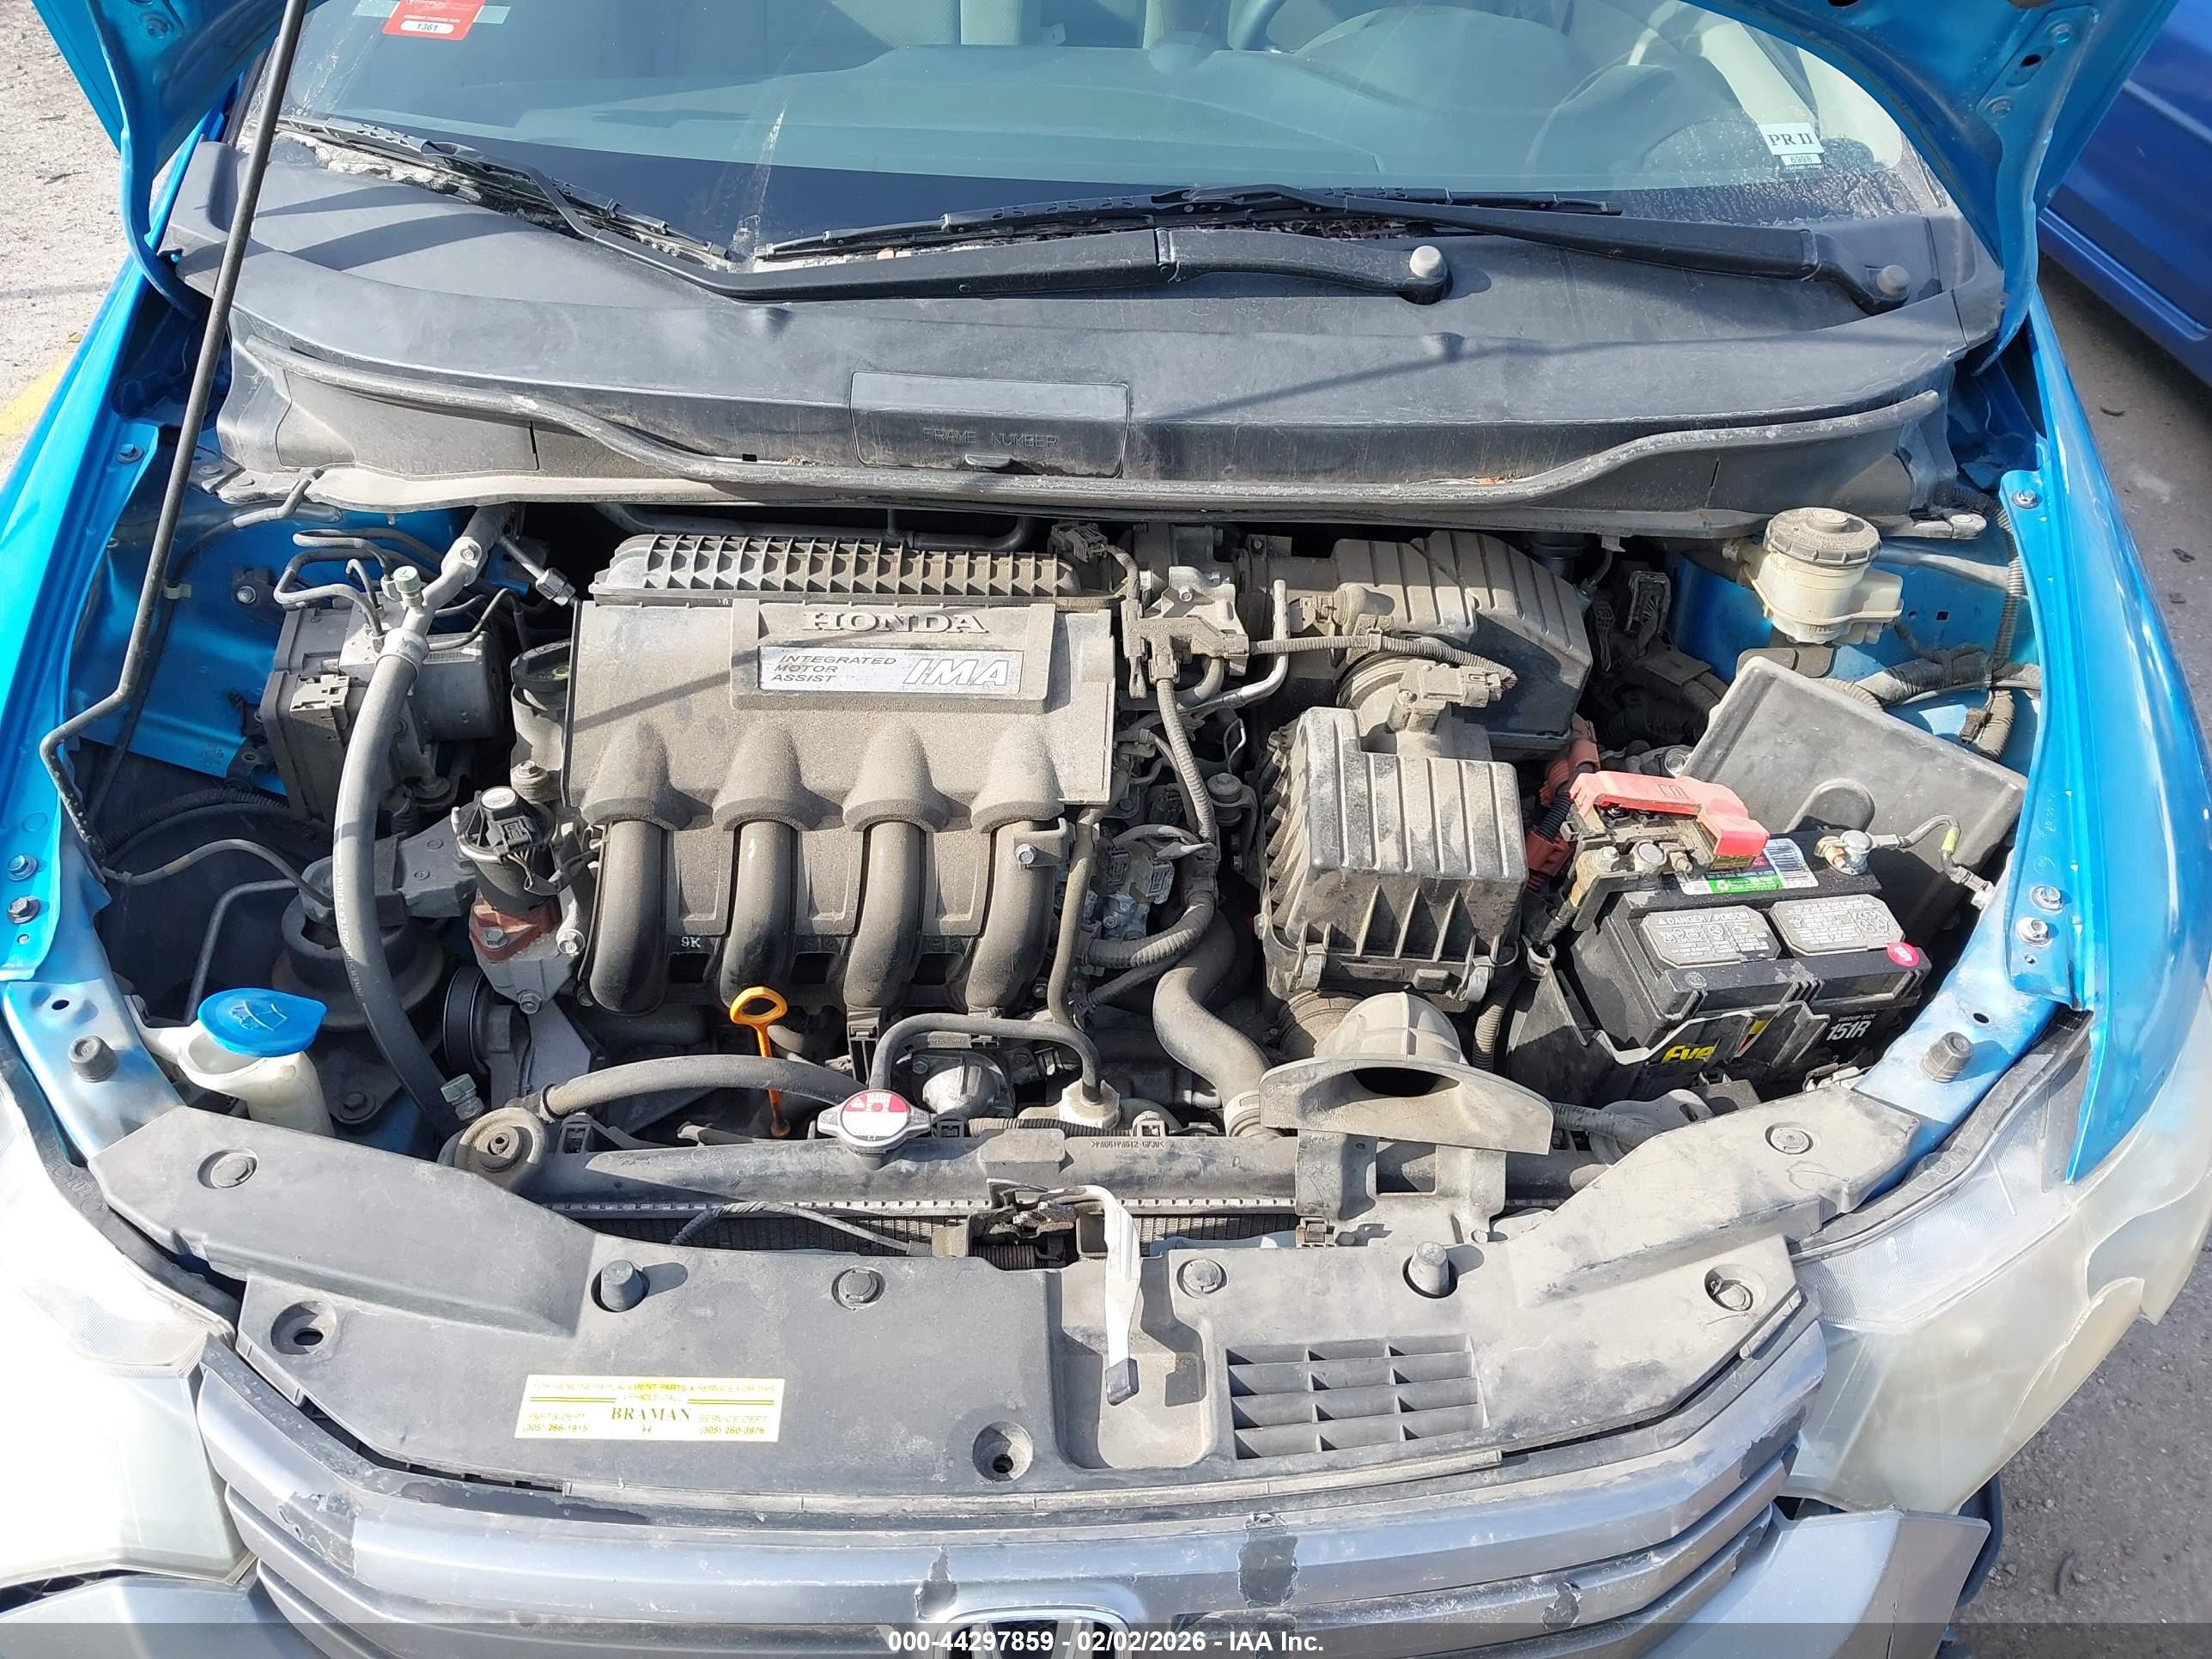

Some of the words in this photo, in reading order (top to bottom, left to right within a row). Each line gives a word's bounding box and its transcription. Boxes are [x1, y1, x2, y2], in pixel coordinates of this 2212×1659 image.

[417, 23, 439, 31] 1361
[1766, 133, 1796, 146] PR
[923, 428, 976, 444] FRAME
[991, 432, 1058, 448] NUMBER
[801, 611, 990, 635] HONDA
[778, 654, 897, 665] INTEGRATED
[774, 664, 839, 674] MOTOR
[902, 658, 1011, 687] IMA
[771, 674, 837, 684] ASSIST
[1666, 915, 1707, 925] DANGER
[1714, 911, 1750, 921] POISON
[681, 936, 702, 948] 9K
[1826, 1020, 1872, 1041] 151R
[659, 1384, 687, 1392] PARTS
[697, 1385, 735, 1393] SERVICE
[611, 1407, 693, 1421] BRAMAN
[699, 1415, 739, 1423] SERVICE
[700, 1426, 722, 1435] (305)
